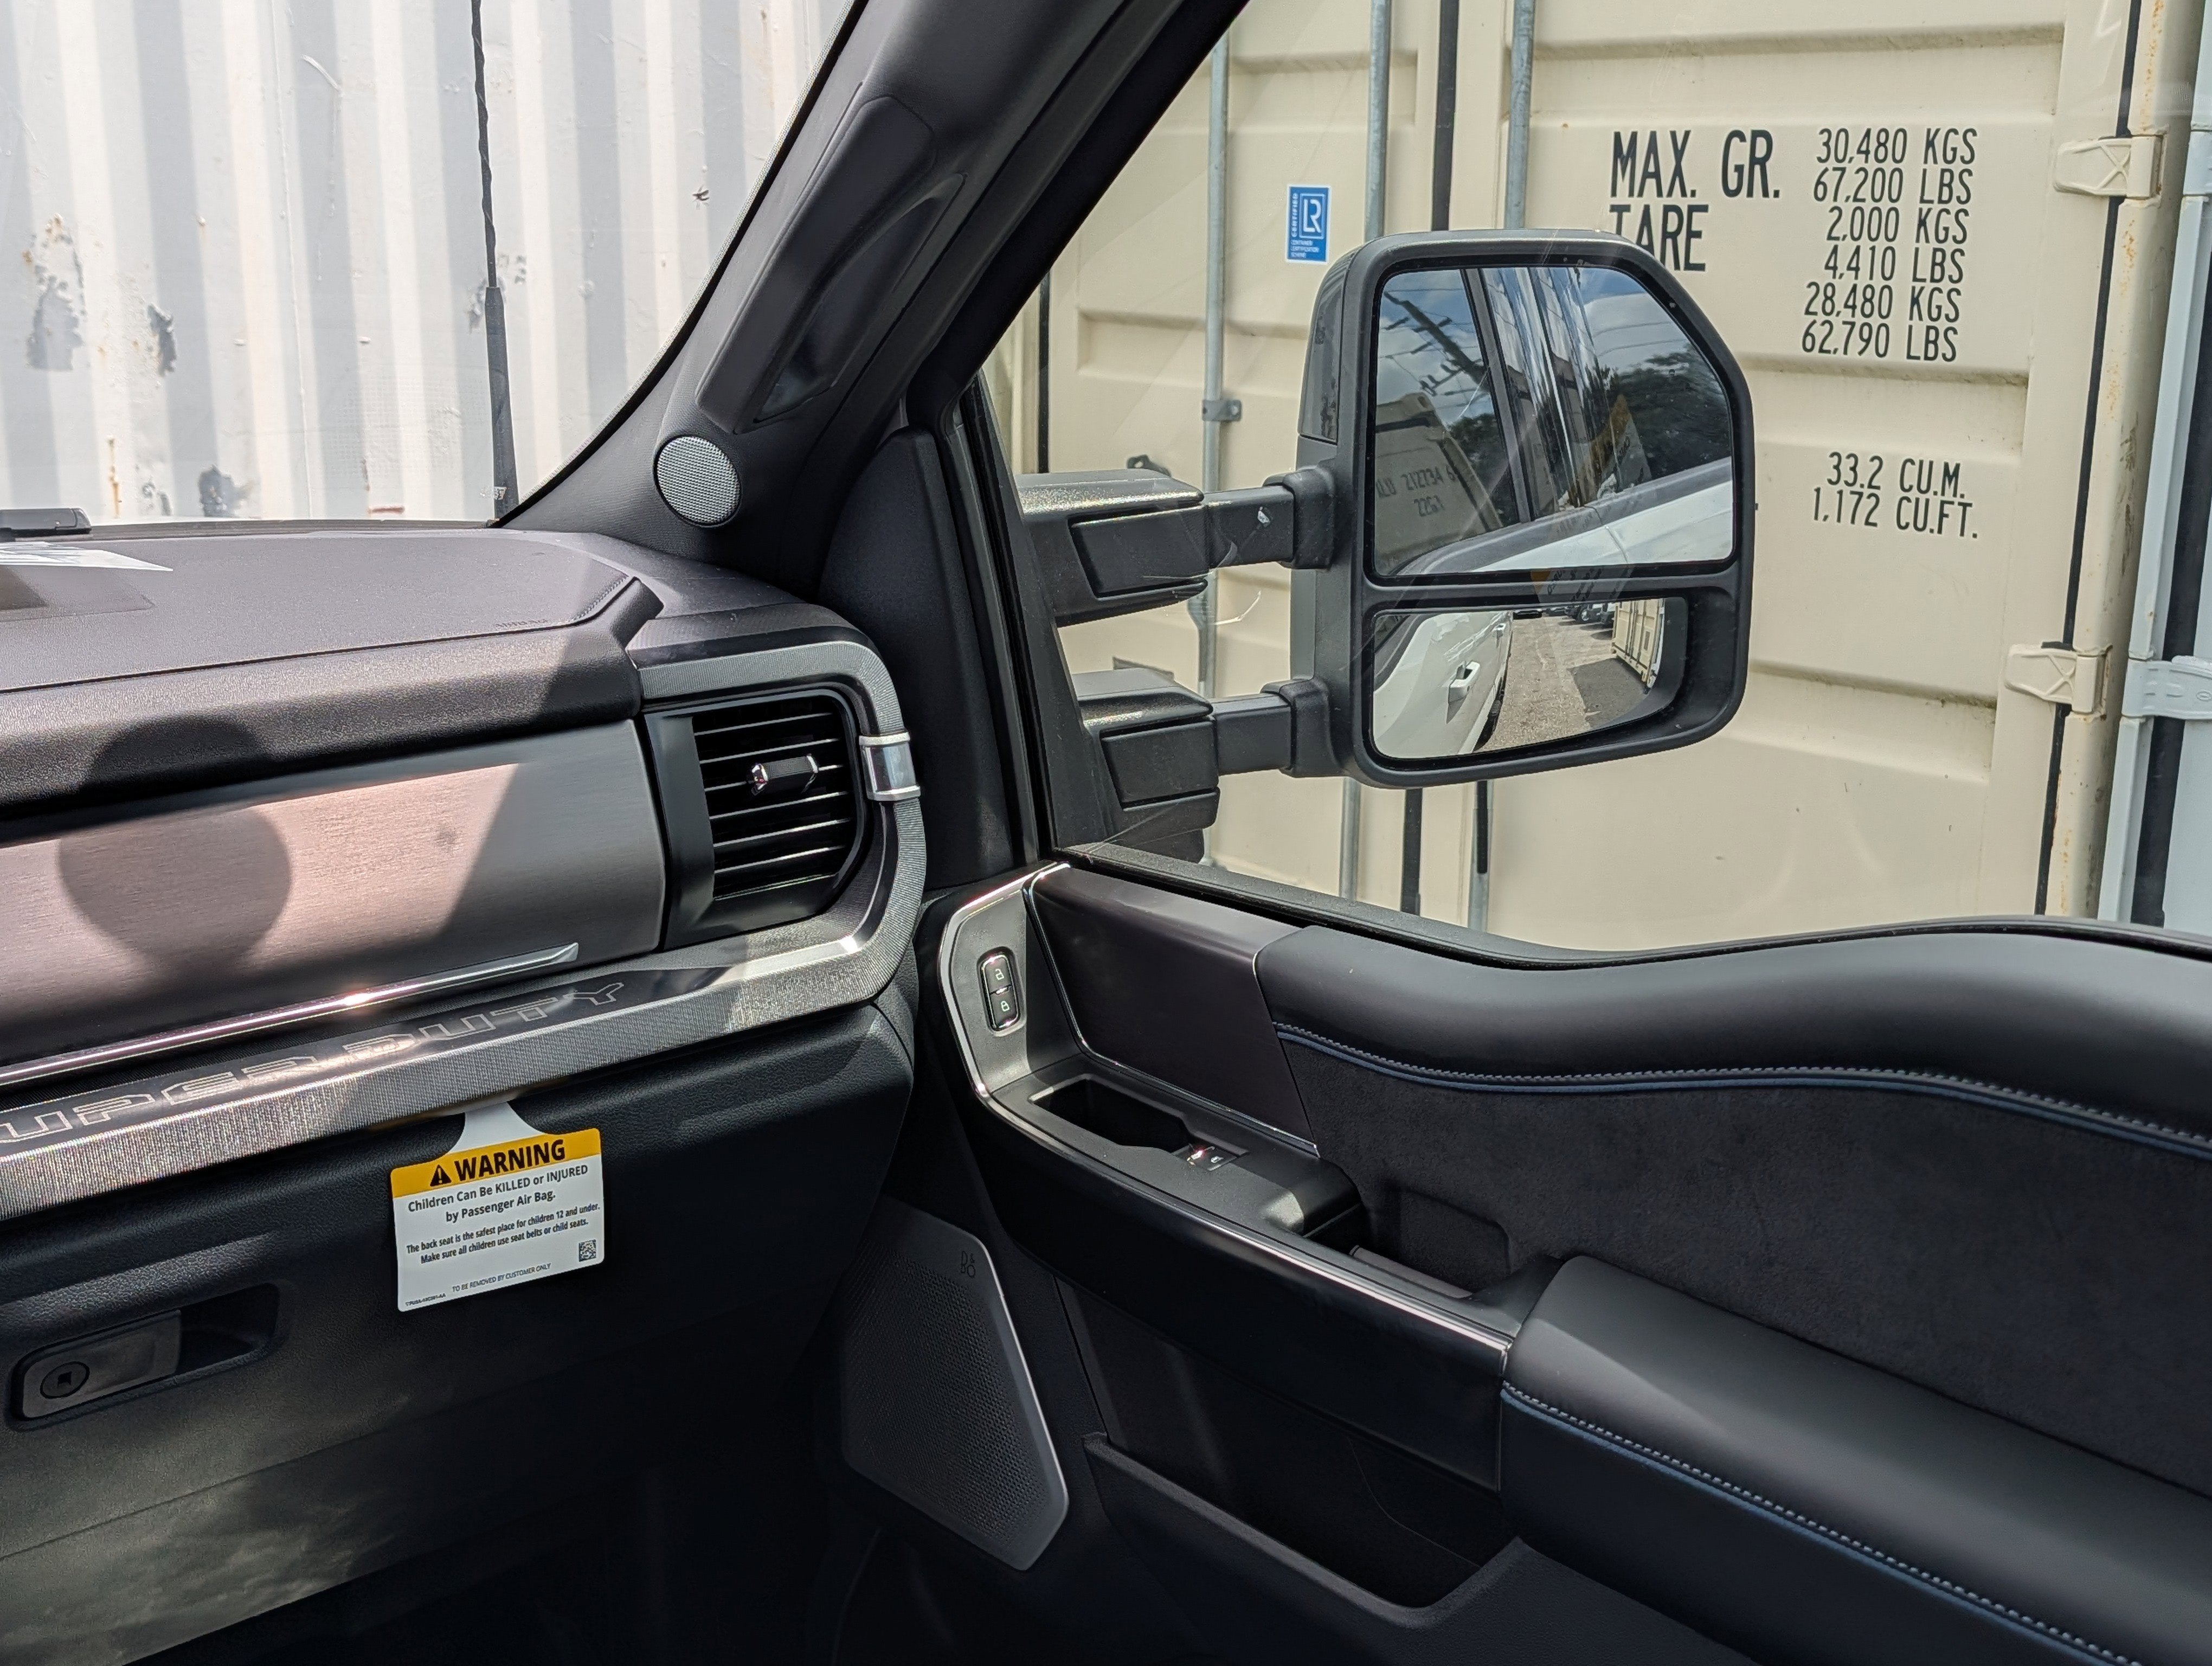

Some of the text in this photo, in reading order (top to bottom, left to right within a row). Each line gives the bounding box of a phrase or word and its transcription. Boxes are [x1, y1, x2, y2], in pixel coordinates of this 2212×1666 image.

[1611, 128, 1978, 198] MAX. GR. 30,480 KGS
[1814, 166, 1973, 205] 67,200 LBS
[1609, 204, 1970, 272] TARE 2,000 KGS
[1824, 244, 1966, 284] 4,410 LBS
[1804, 281, 1962, 323] 28,480 KGS
[1802, 319, 1958, 362] 62,790 LBS
[1827, 451, 1965, 499] 33.2 CU.M.
[1814, 486, 1978, 539] 1,172 CU.FT.
[343, 982, 625, 1059] DUTY
[454, 1139, 565, 1182] WARNING
[408, 1164, 588, 1212] Children Can Be KILLED or INJURED
[446, 1190, 556, 1223] by Passenger Air Bag.
[407, 1203, 601, 1254] The back seat is the safest place for children 12 and under.
[421, 1218, 589, 1264] Make sure all children use seat belts or child seats.
[470, 1276, 497, 1289] REMOVED
[505, 1267, 536, 1279] CUSTOMER
[536, 1263, 552, 1272] ONLY
